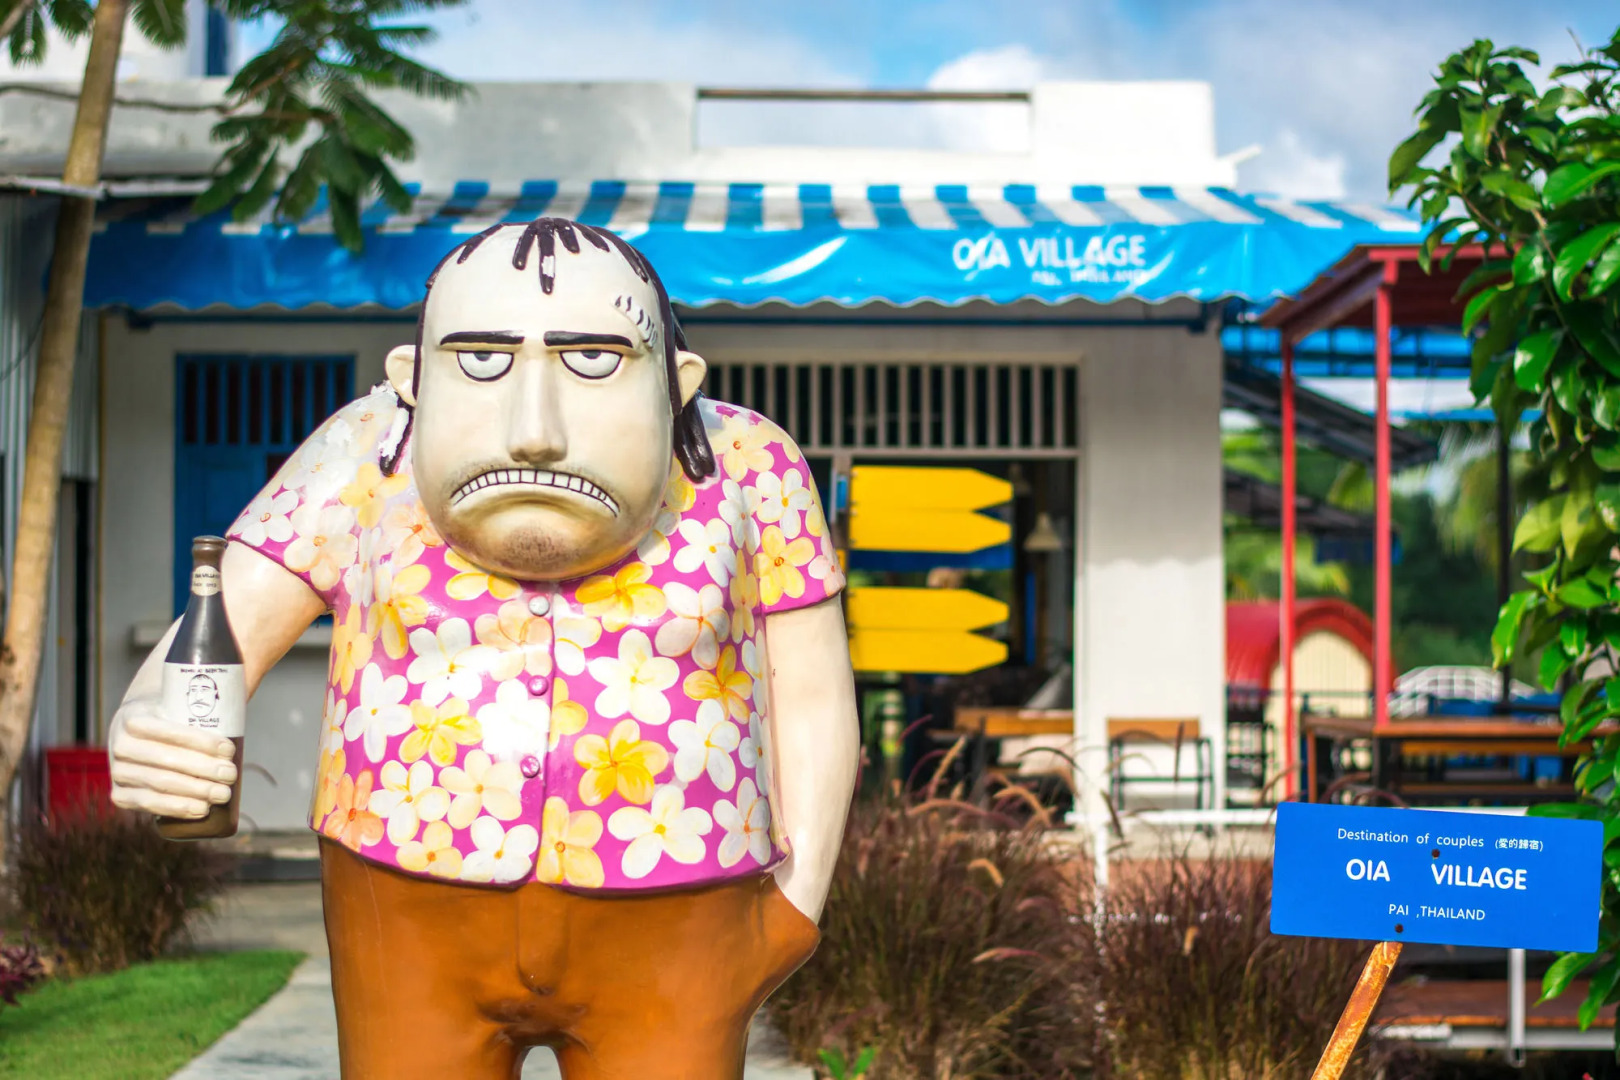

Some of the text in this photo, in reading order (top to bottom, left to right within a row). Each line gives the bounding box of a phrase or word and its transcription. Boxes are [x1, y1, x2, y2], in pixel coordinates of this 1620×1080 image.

[1019, 235, 1146, 268] VILLAGE
[1337, 827, 1409, 844] Destination
[1416, 832, 1429, 845] of
[1436, 834, 1484, 848] couples
[1345, 858, 1527, 890] OIA VILLAGE
[1388, 903, 1409, 916] PAI
